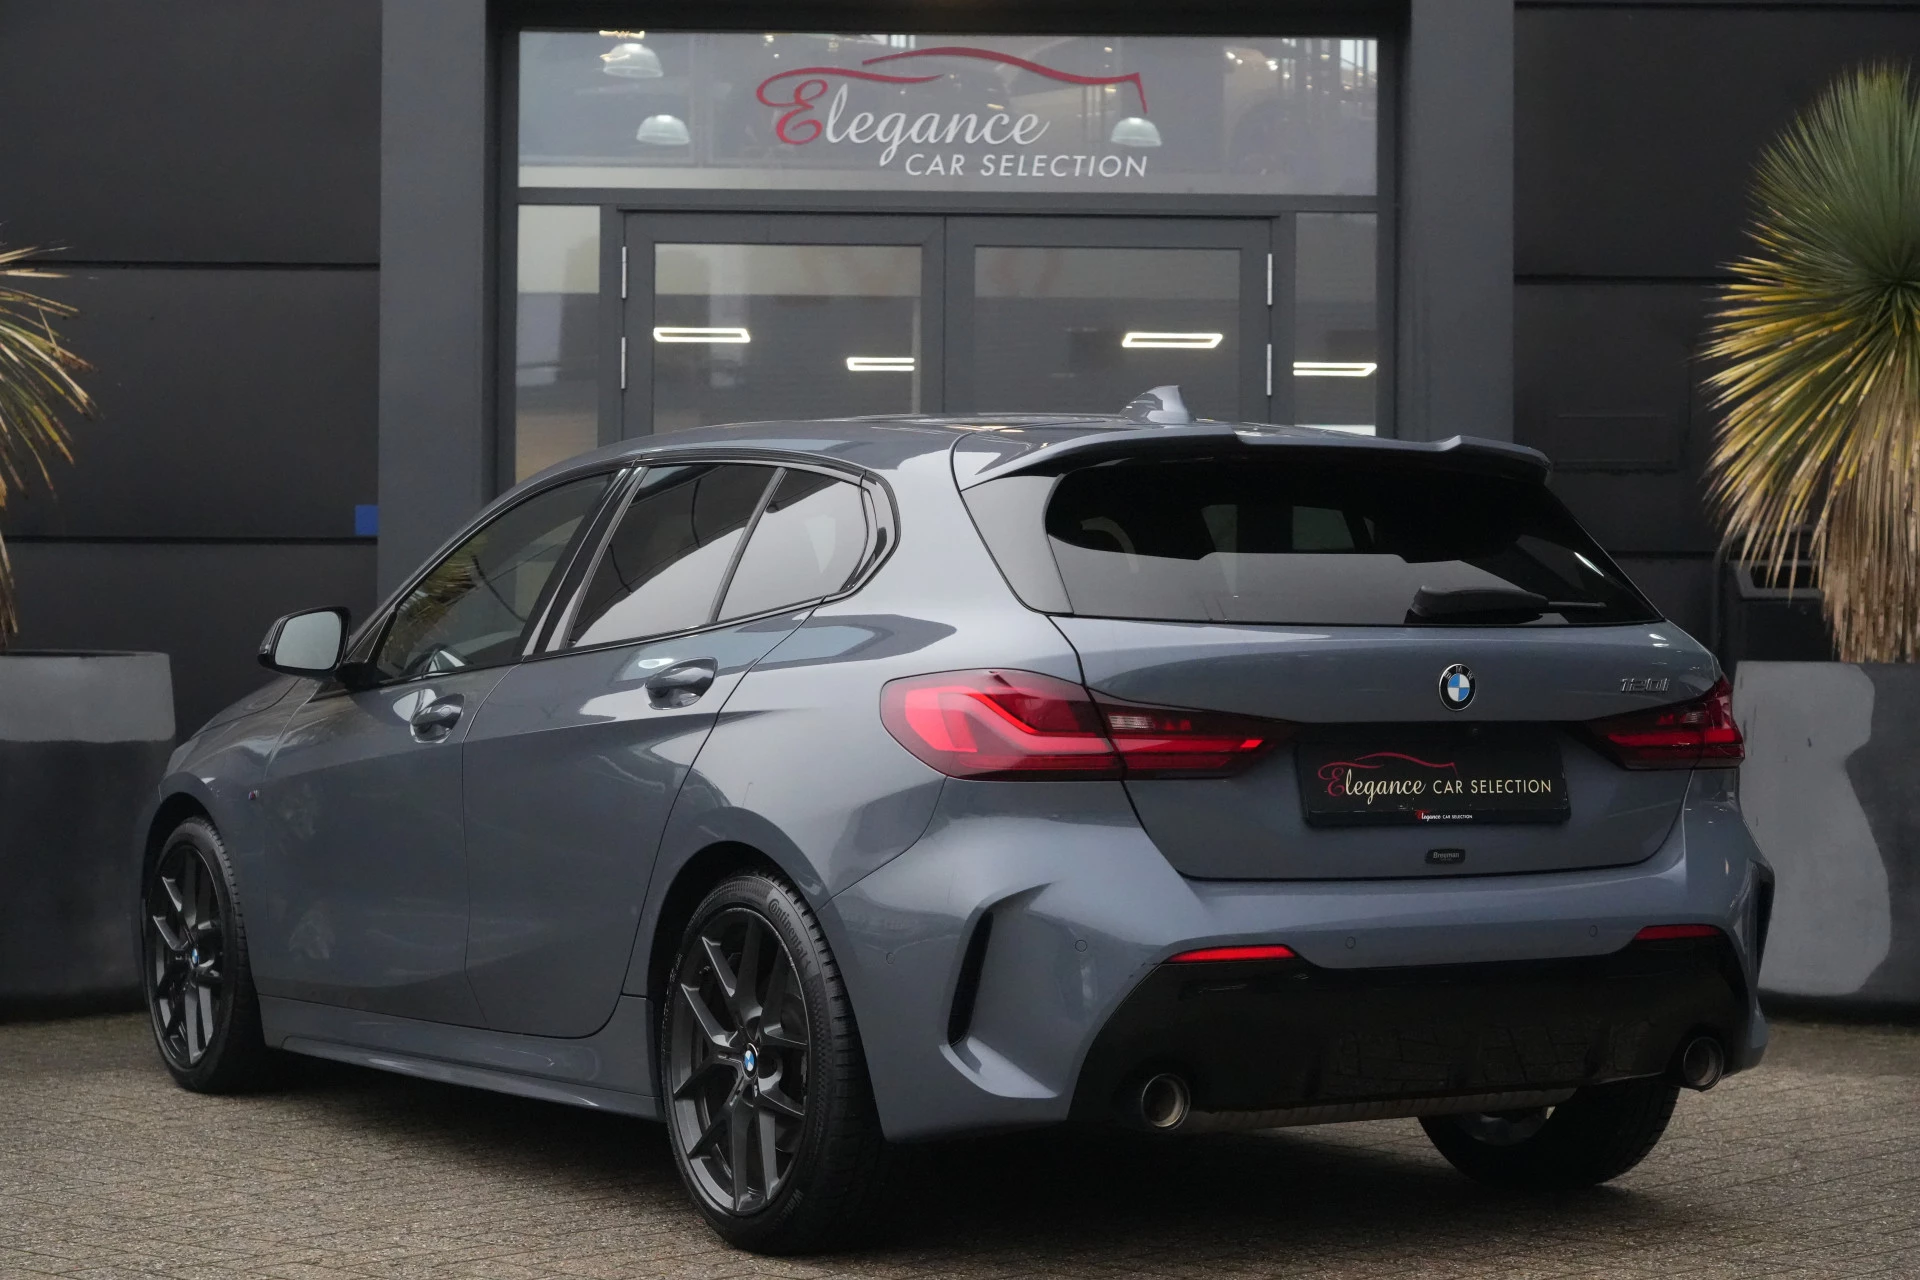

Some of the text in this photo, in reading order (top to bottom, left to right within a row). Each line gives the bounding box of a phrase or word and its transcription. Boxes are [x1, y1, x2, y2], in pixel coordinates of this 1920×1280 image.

[756, 66, 1050, 167] Elegance
[904, 153, 1148, 178] CAR SELECTION
[1317, 761, 1552, 805] Elegance CAR SELECTION
[768, 898, 808, 960] Continental
